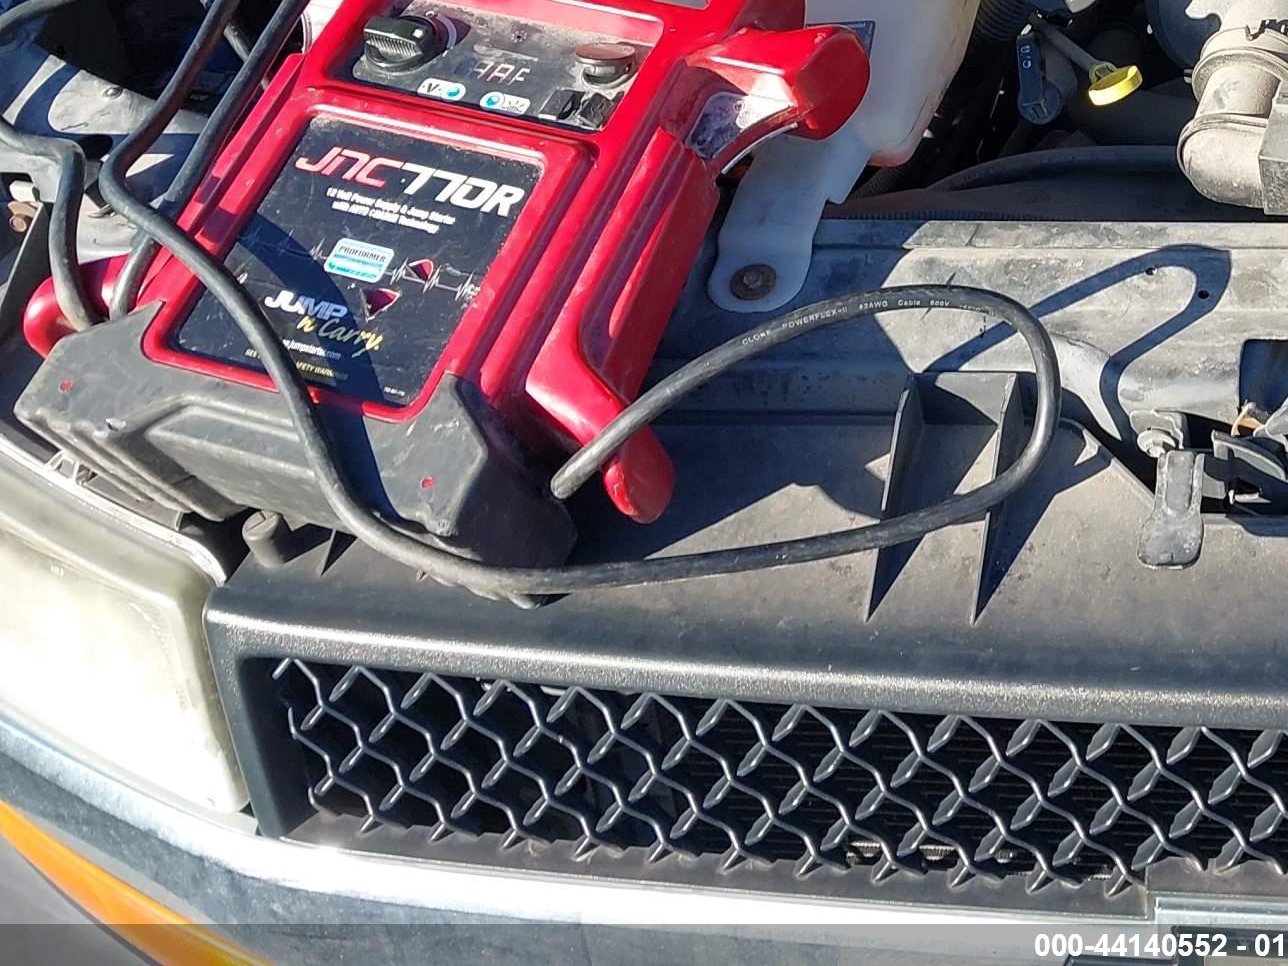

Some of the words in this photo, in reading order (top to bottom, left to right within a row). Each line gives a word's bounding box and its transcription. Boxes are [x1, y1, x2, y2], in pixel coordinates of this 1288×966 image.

[264, 290, 348, 320] JUMP
[898, 299, 921, 307] Cable
[297, 315, 317, 333] n
